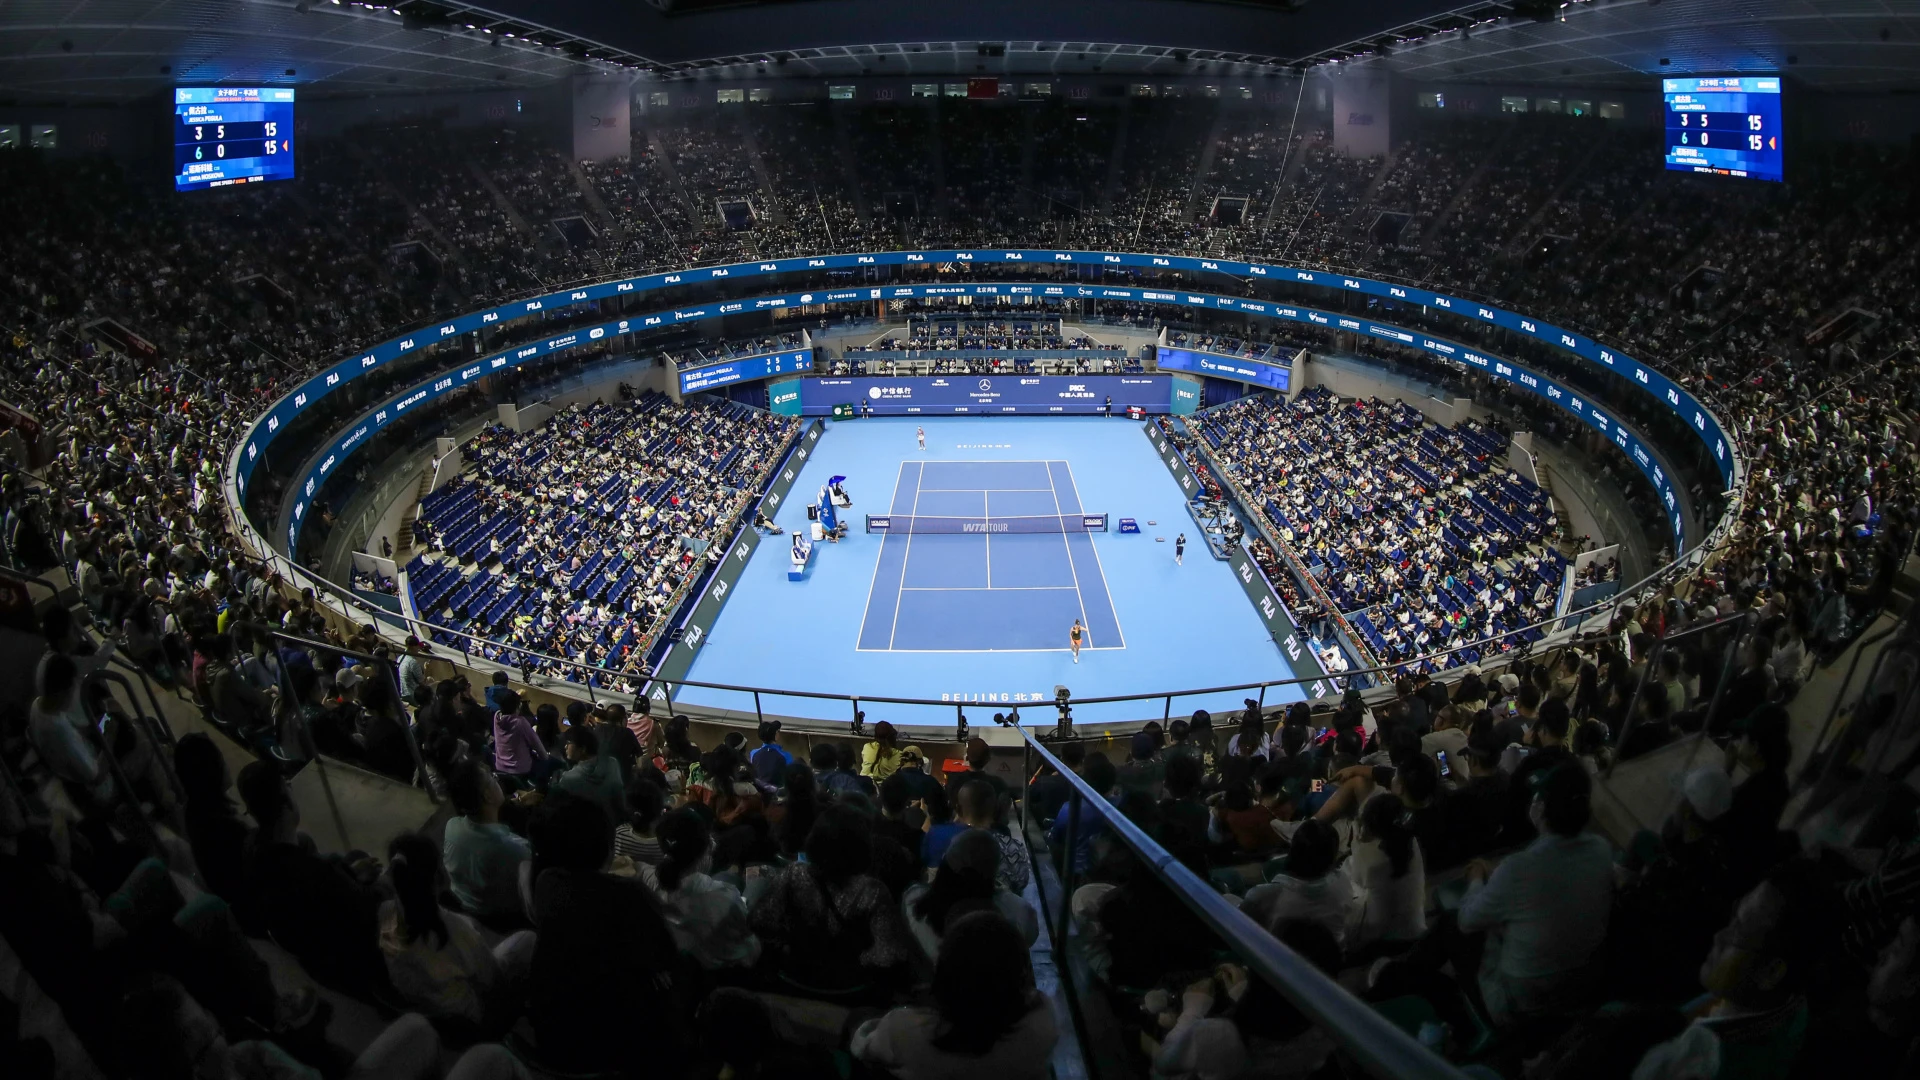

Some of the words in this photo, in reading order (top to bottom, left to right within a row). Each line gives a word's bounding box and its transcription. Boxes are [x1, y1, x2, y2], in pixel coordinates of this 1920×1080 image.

[1681, 114, 1688, 126] 3
[1701, 114, 1708, 127] 5
[1748, 115, 1761, 130] 15
[195, 127, 202, 140] 3
[218, 125, 224, 138] 5
[265, 123, 276, 136] 15
[1682, 132, 1688, 144] 6
[1701, 132, 1708, 145] 0
[1748, 135, 1762, 150] 15
[196, 147, 202, 160] 6
[217, 144, 224, 157] 0
[265, 141, 276, 154] 15
[665, 275, 680, 283] FILA
[712, 269, 728, 277] FILA
[618, 283, 633, 291] FILA
[1344, 280, 1359, 288] FILA
[572, 292, 587, 300] FILA
[1391, 288, 1405, 297] FILA
[527, 301, 542, 311] FILA
[1436, 298, 1450, 307] FILA
[483, 313, 498, 322] FILA
[1479, 309, 1493, 319] FILA
[646, 317, 661, 325] FILA
[1521, 321, 1535, 332] FILA
[441, 325, 455, 336] FILA
[400, 339, 414, 351] FILA
[1562, 335, 1575, 347] FILA
[362, 355, 375, 367] FILA
[1601, 351, 1613, 364] FILA
[327, 373, 339, 386] FILA
[1636, 369, 1648, 383] FILA
[295, 393, 306, 408] FILA
[1668, 389, 1678, 405] FILA
[809, 430, 817, 441] FILA
[1149, 426, 1157, 439] FILA
[1159, 441, 1167, 453] FILA
[798, 448, 806, 460] FILA
[1170, 457, 1178, 470] FILA
[784, 469, 793, 482] FILA
[1182, 475, 1191, 489] FILA
[769, 493, 779, 508] FILA
[963, 524, 986, 532] WTA
[989, 524, 1008, 532] TOUR
[736, 543, 749, 561] FILA
[1239, 562, 1253, 583] FILA
[713, 580, 727, 601] FILA
[1260, 596, 1275, 619] FILA
[685, 625, 702, 649] FILA
[1284, 634, 1301, 661] FILA
[942, 693, 1009, 702] BEIJING
[1013, 693, 1044, 701] 北京
